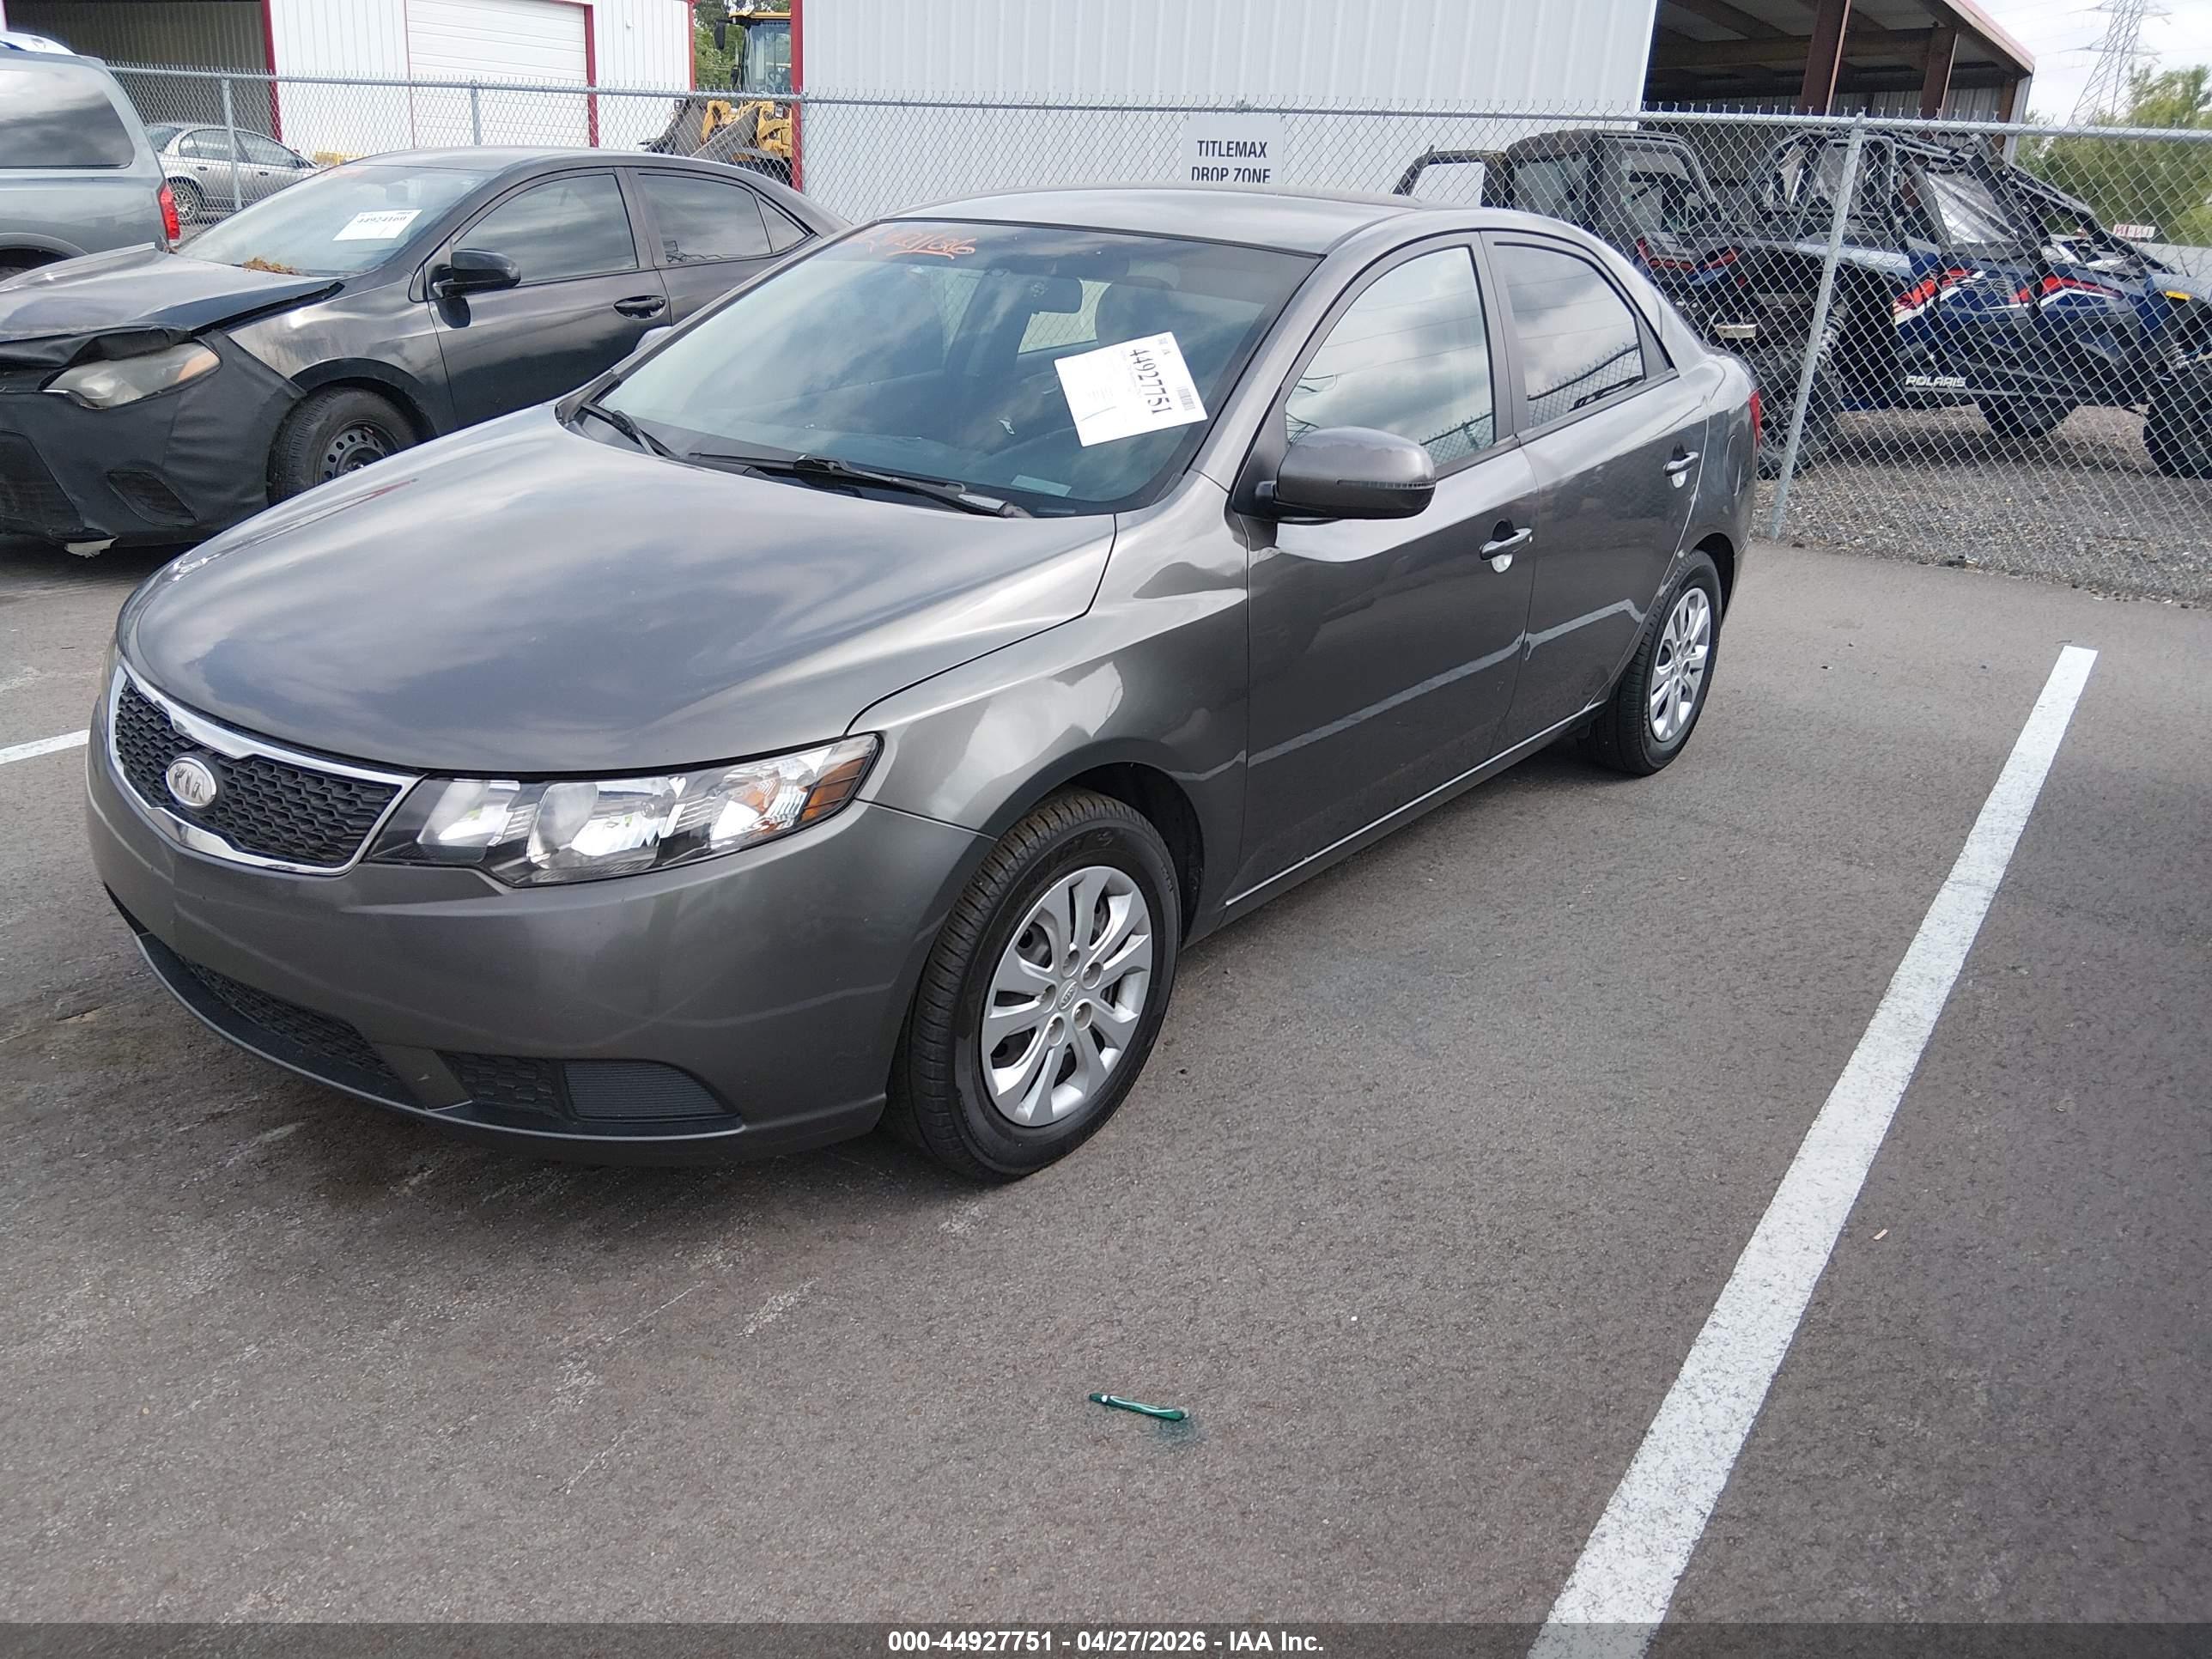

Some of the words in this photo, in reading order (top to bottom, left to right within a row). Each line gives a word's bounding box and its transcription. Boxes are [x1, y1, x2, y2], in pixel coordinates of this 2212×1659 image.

[1197, 140, 1267, 158] TITLEMAX
[1191, 167, 1229, 182] DROP
[1233, 167, 1271, 184] ZONE
[1129, 349, 1173, 415] 44927751
[1905, 375, 1966, 387] POLARIS
